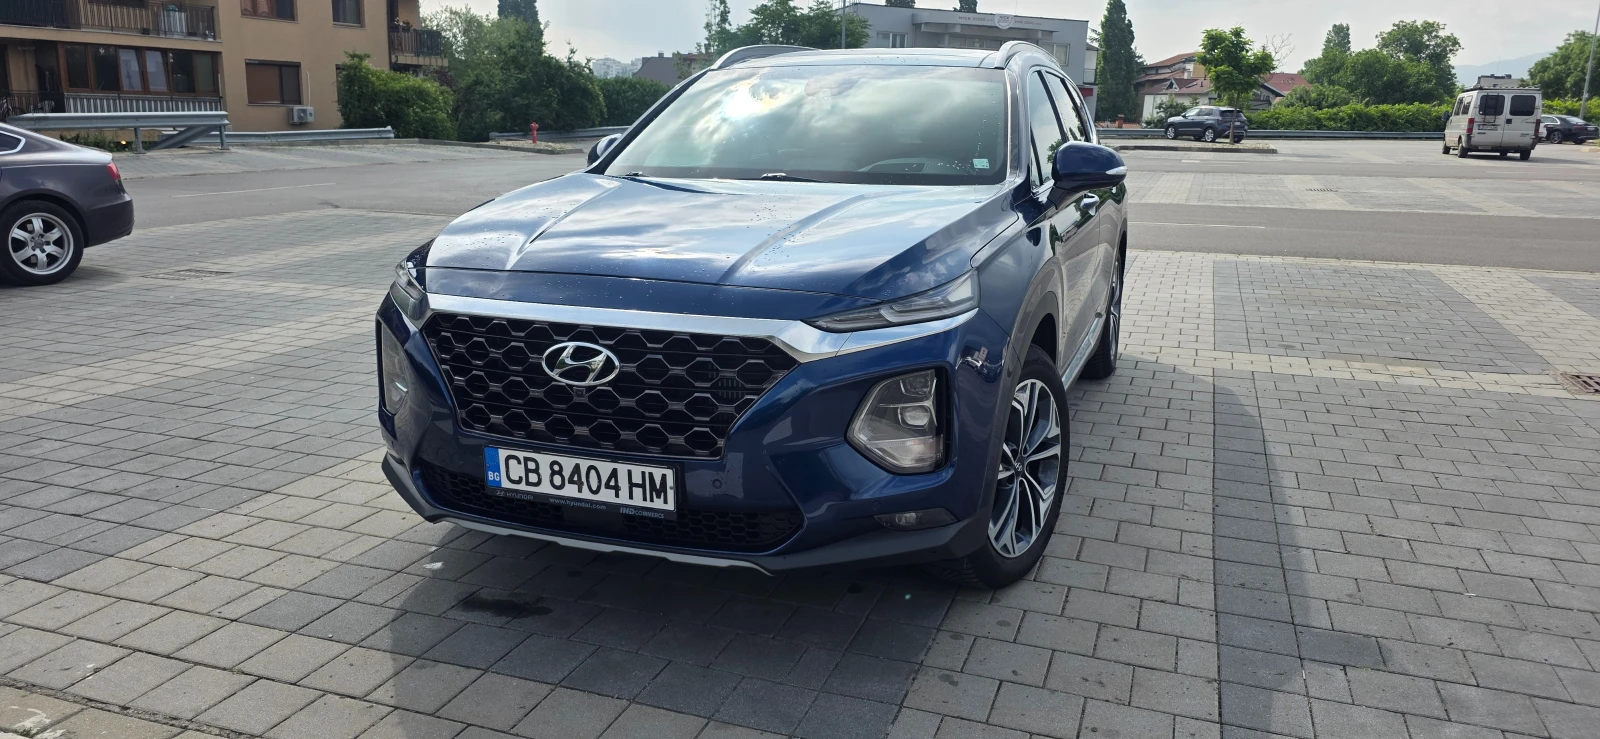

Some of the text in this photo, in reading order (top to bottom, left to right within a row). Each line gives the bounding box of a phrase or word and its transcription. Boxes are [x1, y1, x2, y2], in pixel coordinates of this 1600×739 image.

[488, 471, 500, 481] BG
[504, 454, 669, 505] CB 8404 HM
[506, 492, 534, 500] HYUNDAI
[549, 498, 607, 510] www.hyundai.com
